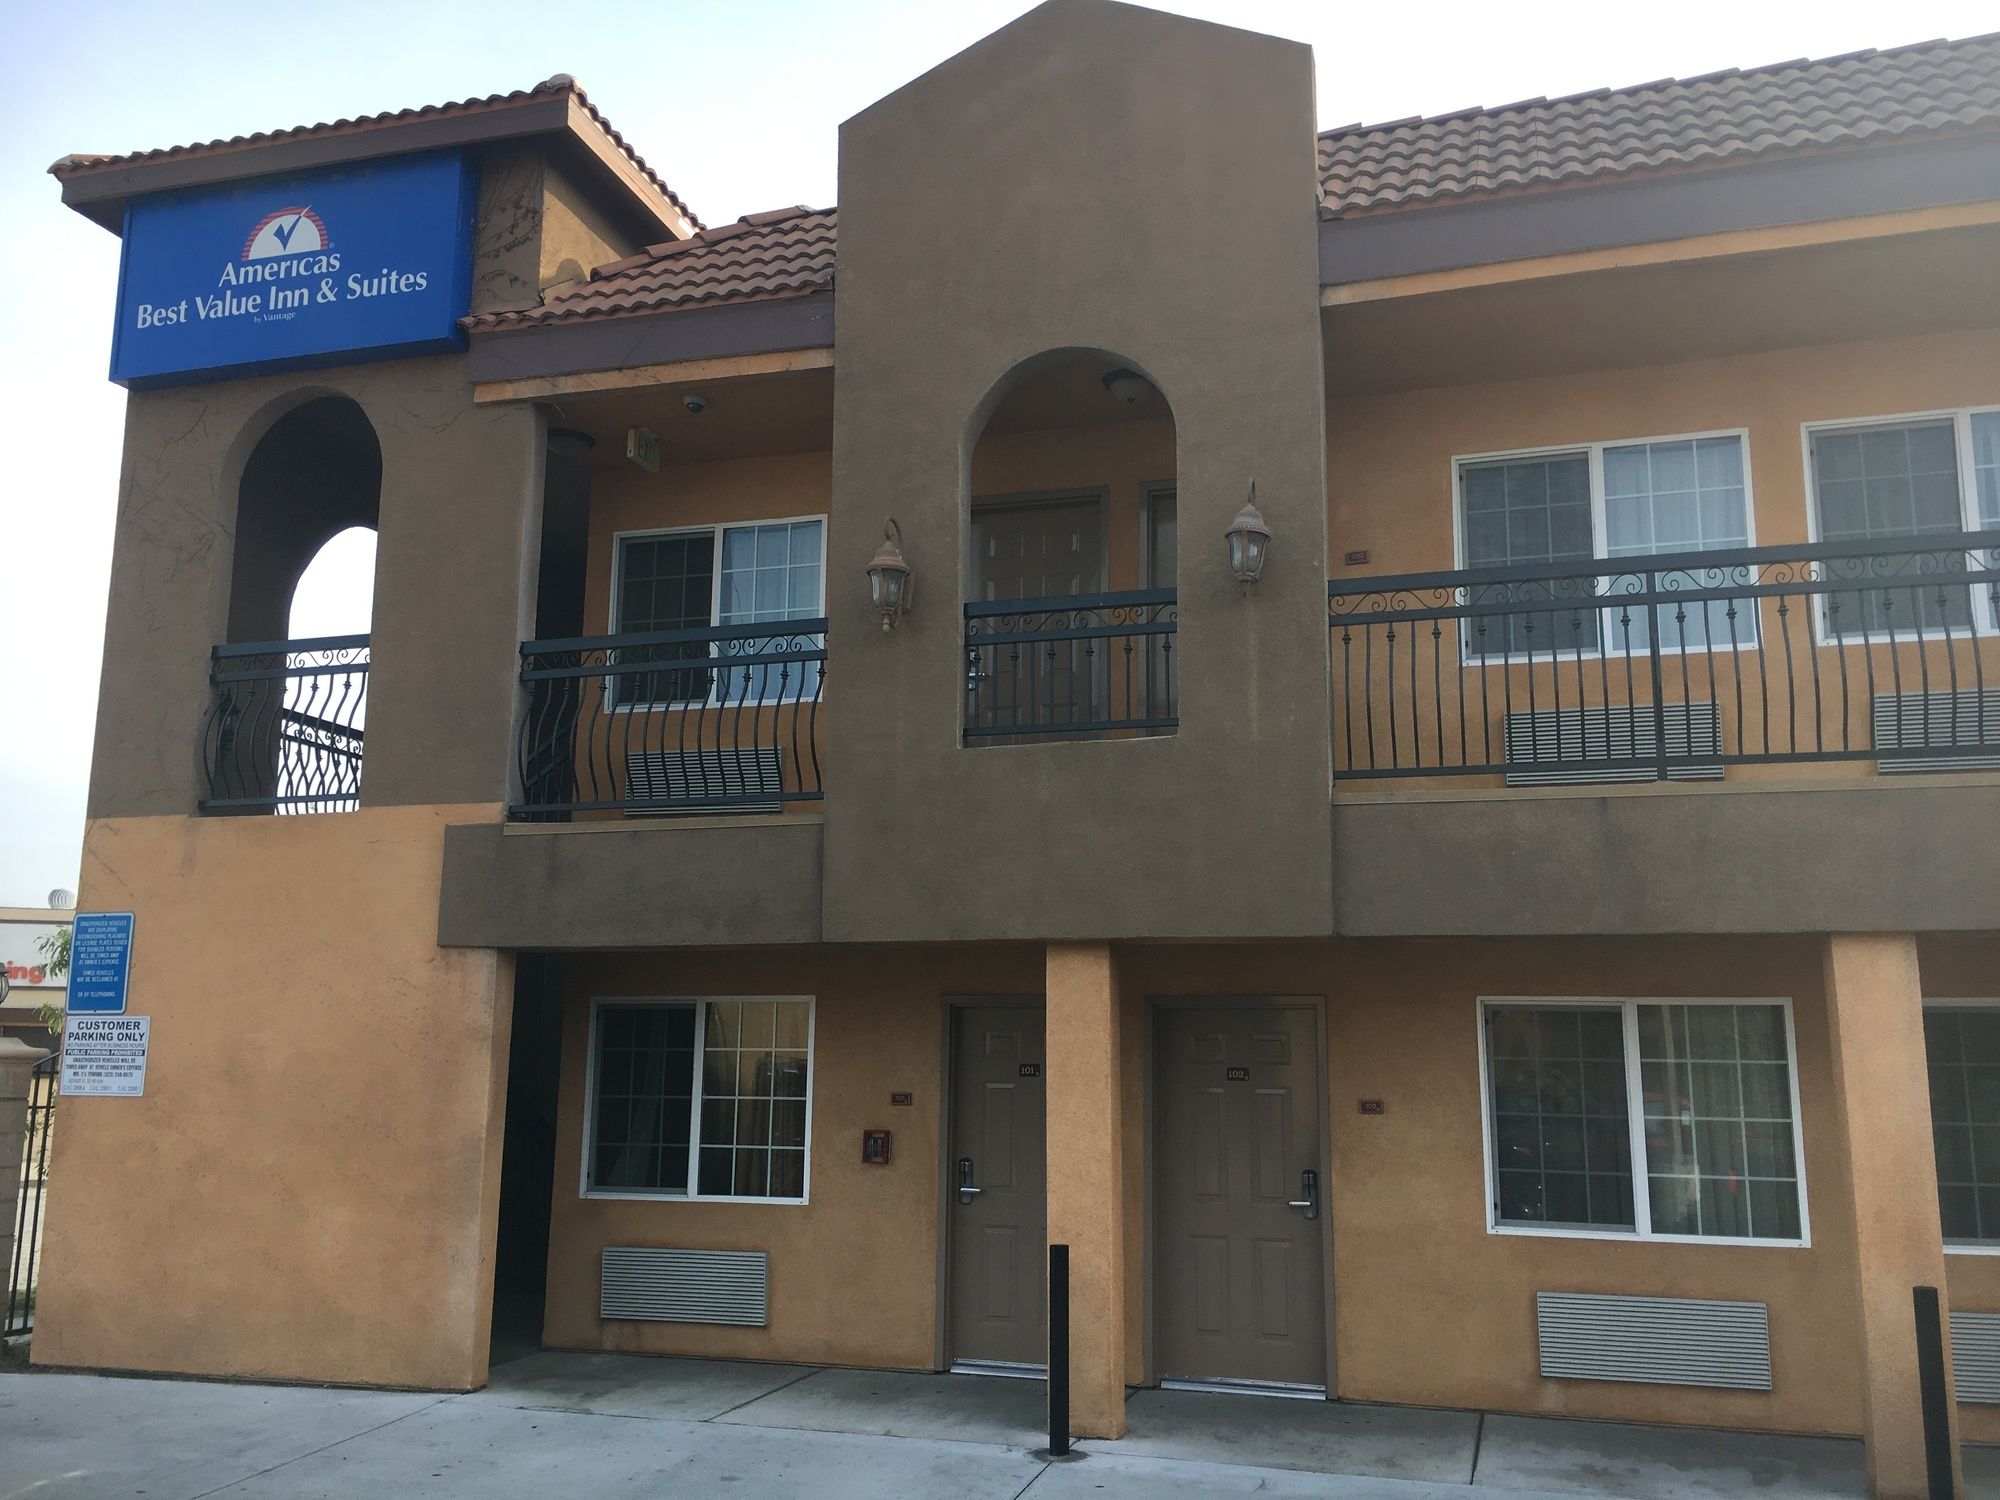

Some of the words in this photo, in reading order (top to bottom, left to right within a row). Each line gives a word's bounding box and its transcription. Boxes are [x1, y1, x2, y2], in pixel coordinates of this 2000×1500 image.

[218, 252, 341, 287] Americas
[137, 299, 188, 329] Best
[195, 289, 261, 321] Value
[269, 285, 309, 311] Inn
[316, 277, 338, 304] &
[347, 268, 428, 300] Suites
[253, 315, 262, 324] by
[263, 310, 297, 323] Vantage
[77, 1020, 141, 1031] CUSTOMER
[68, 1032, 114, 1042] PARKING
[116, 1032, 145, 1042] ONLY
[1021, 1066, 1035, 1074] 101
[1228, 1070, 1244, 1078] 102
